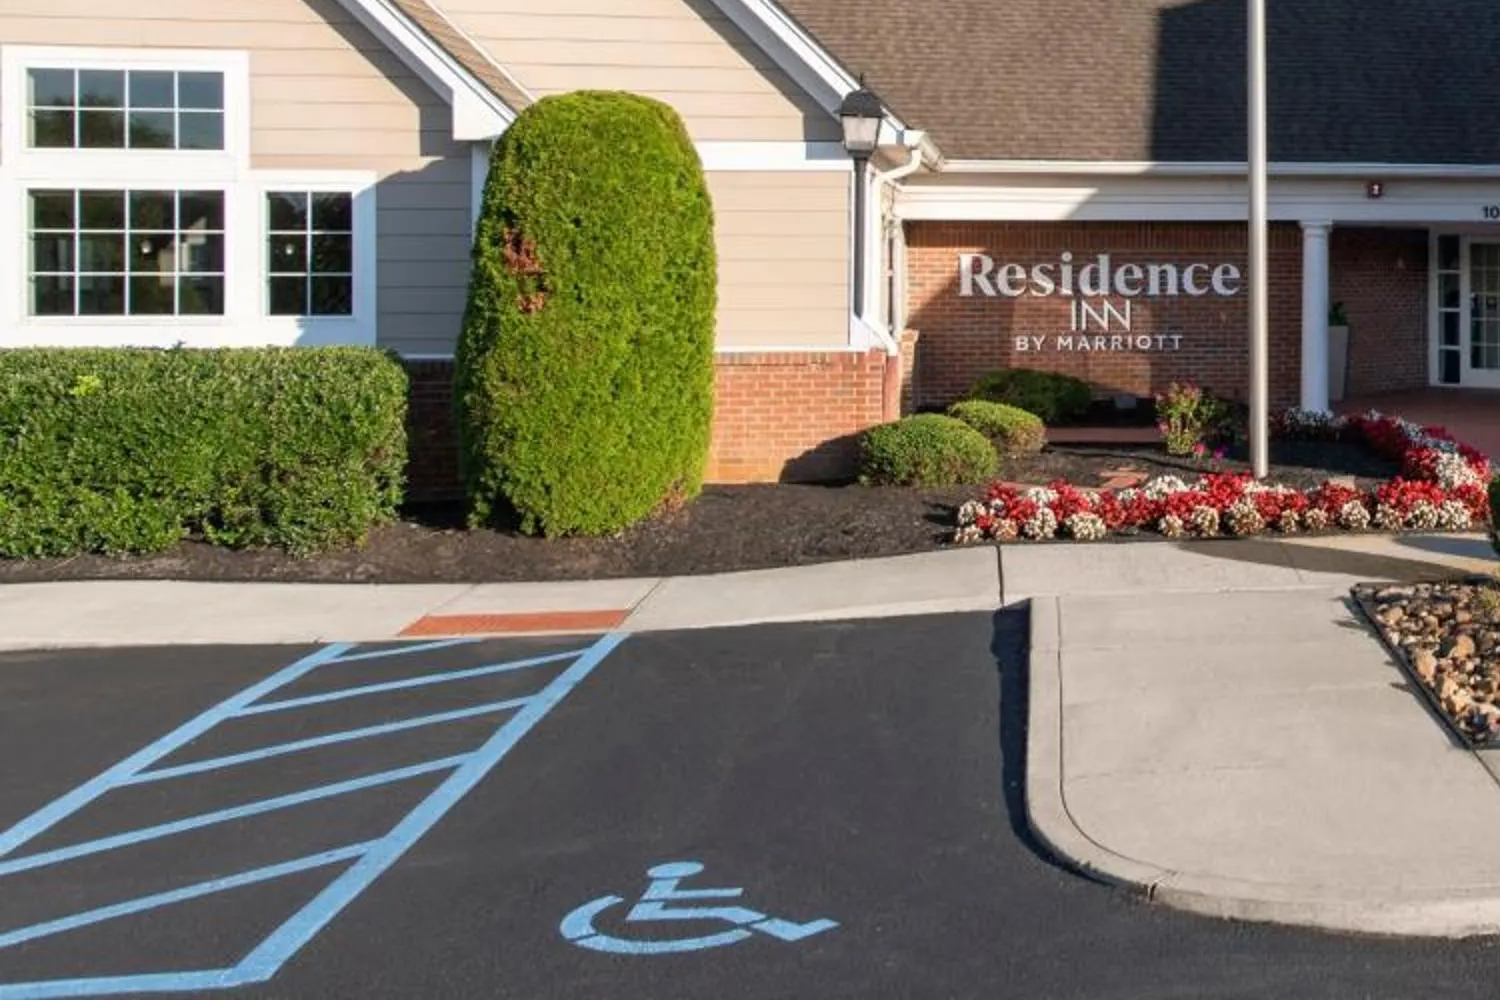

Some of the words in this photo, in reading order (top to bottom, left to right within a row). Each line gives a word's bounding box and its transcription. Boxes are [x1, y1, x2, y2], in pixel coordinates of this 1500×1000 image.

[958, 251, 1241, 297] Residence
[1071, 299, 1132, 331] INN
[1015, 335, 1046, 351] BY
[1057, 334, 1184, 351] MARRIOTT
